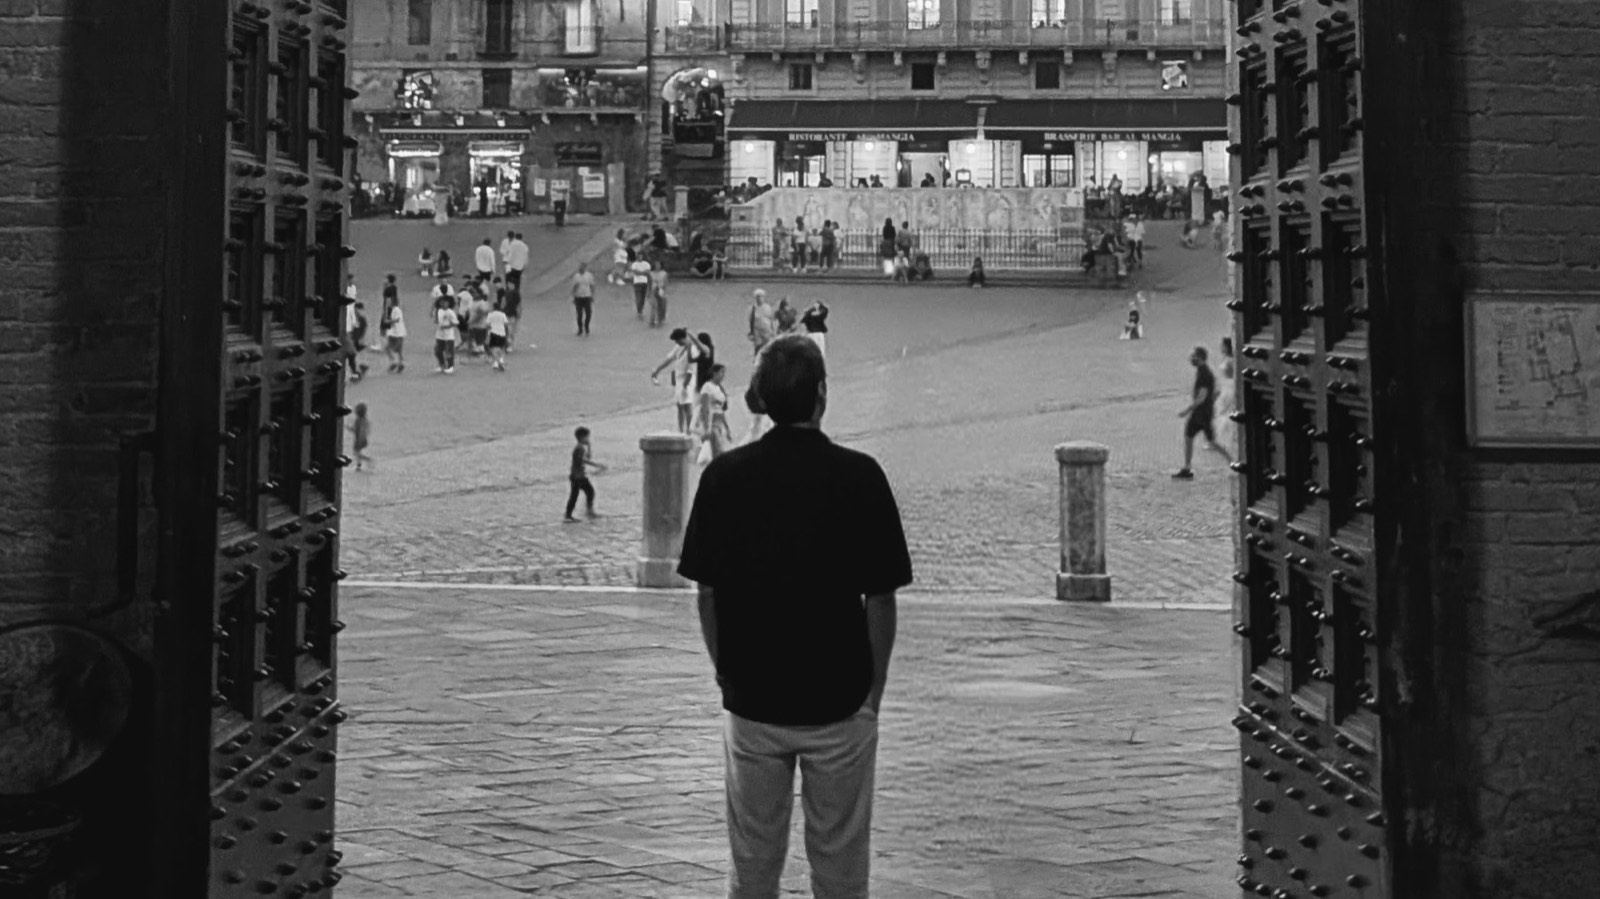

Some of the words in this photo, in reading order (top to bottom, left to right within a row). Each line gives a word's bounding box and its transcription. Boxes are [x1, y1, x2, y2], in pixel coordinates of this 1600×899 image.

[789, 133, 848, 141] RISTORANTE
[876, 133, 915, 141] MANGIA
[1044, 132, 1095, 141] BRASSERIE
[1101, 132, 1121, 141] BAR
[1141, 132, 1181, 141] MANGIA
